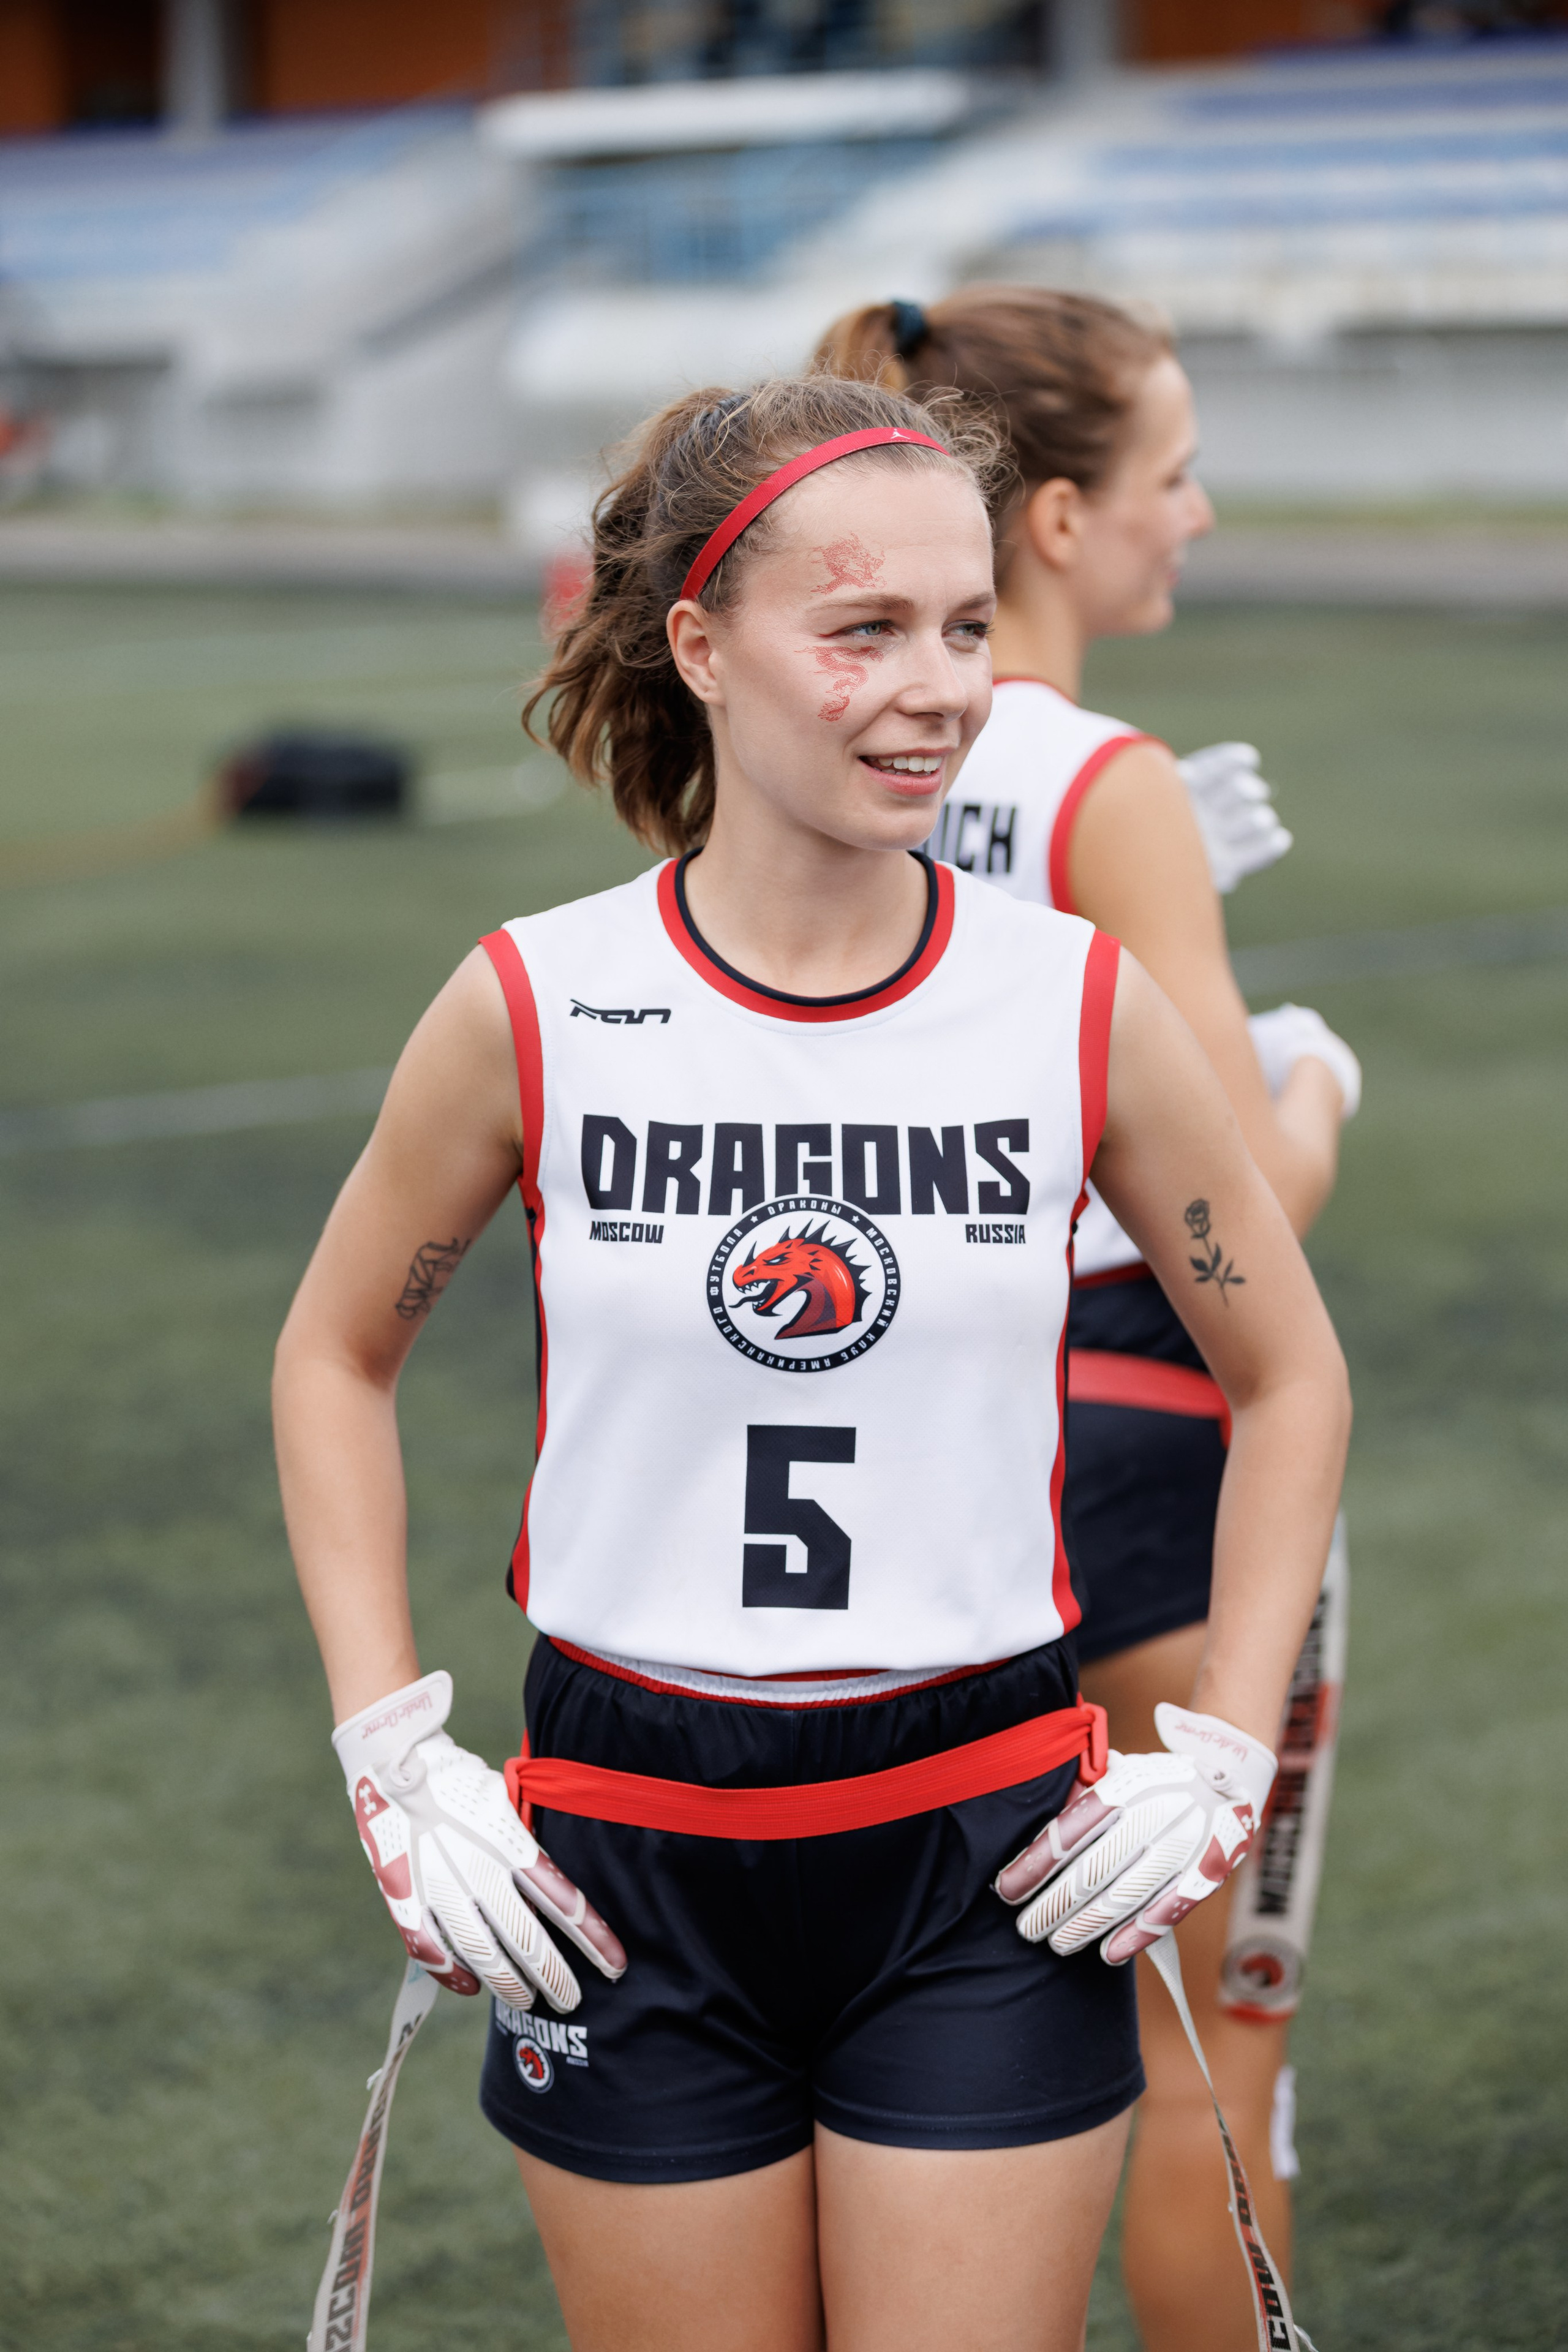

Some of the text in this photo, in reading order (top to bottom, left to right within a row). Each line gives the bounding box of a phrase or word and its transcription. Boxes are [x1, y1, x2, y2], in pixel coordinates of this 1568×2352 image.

[581, 1114, 1030, 1216] DRAGONS
[767, 1199, 842, 1216] ДРАКОНЫ
[589, 1221, 664, 1244] MOSCOW
[965, 1224, 1026, 1244] RUSSIA
[709, 1228, 743, 1296] ФУТБОЛА
[865, 1227, 897, 1328] МОСКОВСКИЙ
[840, 1332, 876, 1361] КЛУБ
[742, 1424, 857, 1610] 5
